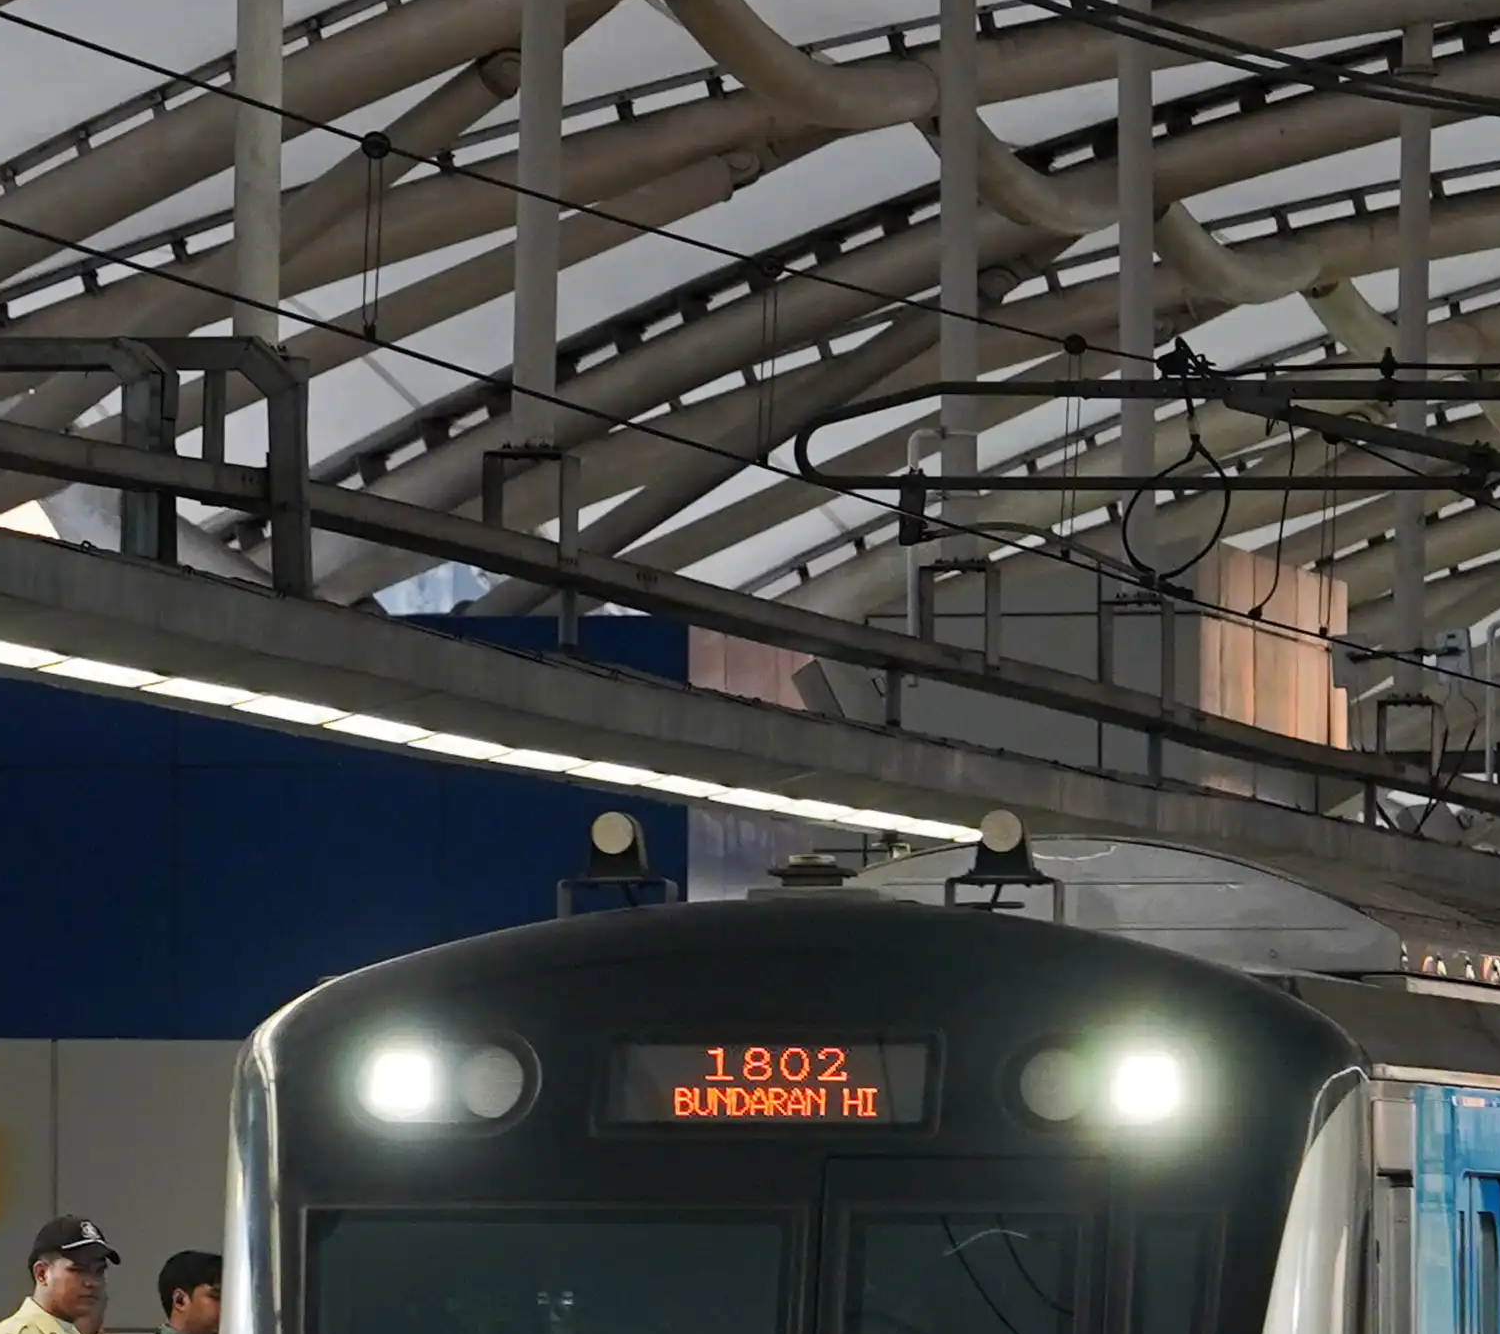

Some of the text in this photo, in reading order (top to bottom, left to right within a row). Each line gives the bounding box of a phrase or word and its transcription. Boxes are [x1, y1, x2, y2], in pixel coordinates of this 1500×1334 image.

[704, 1047, 848, 1081] 1802
[674, 1087, 879, 1117] BUNDARAN HI
